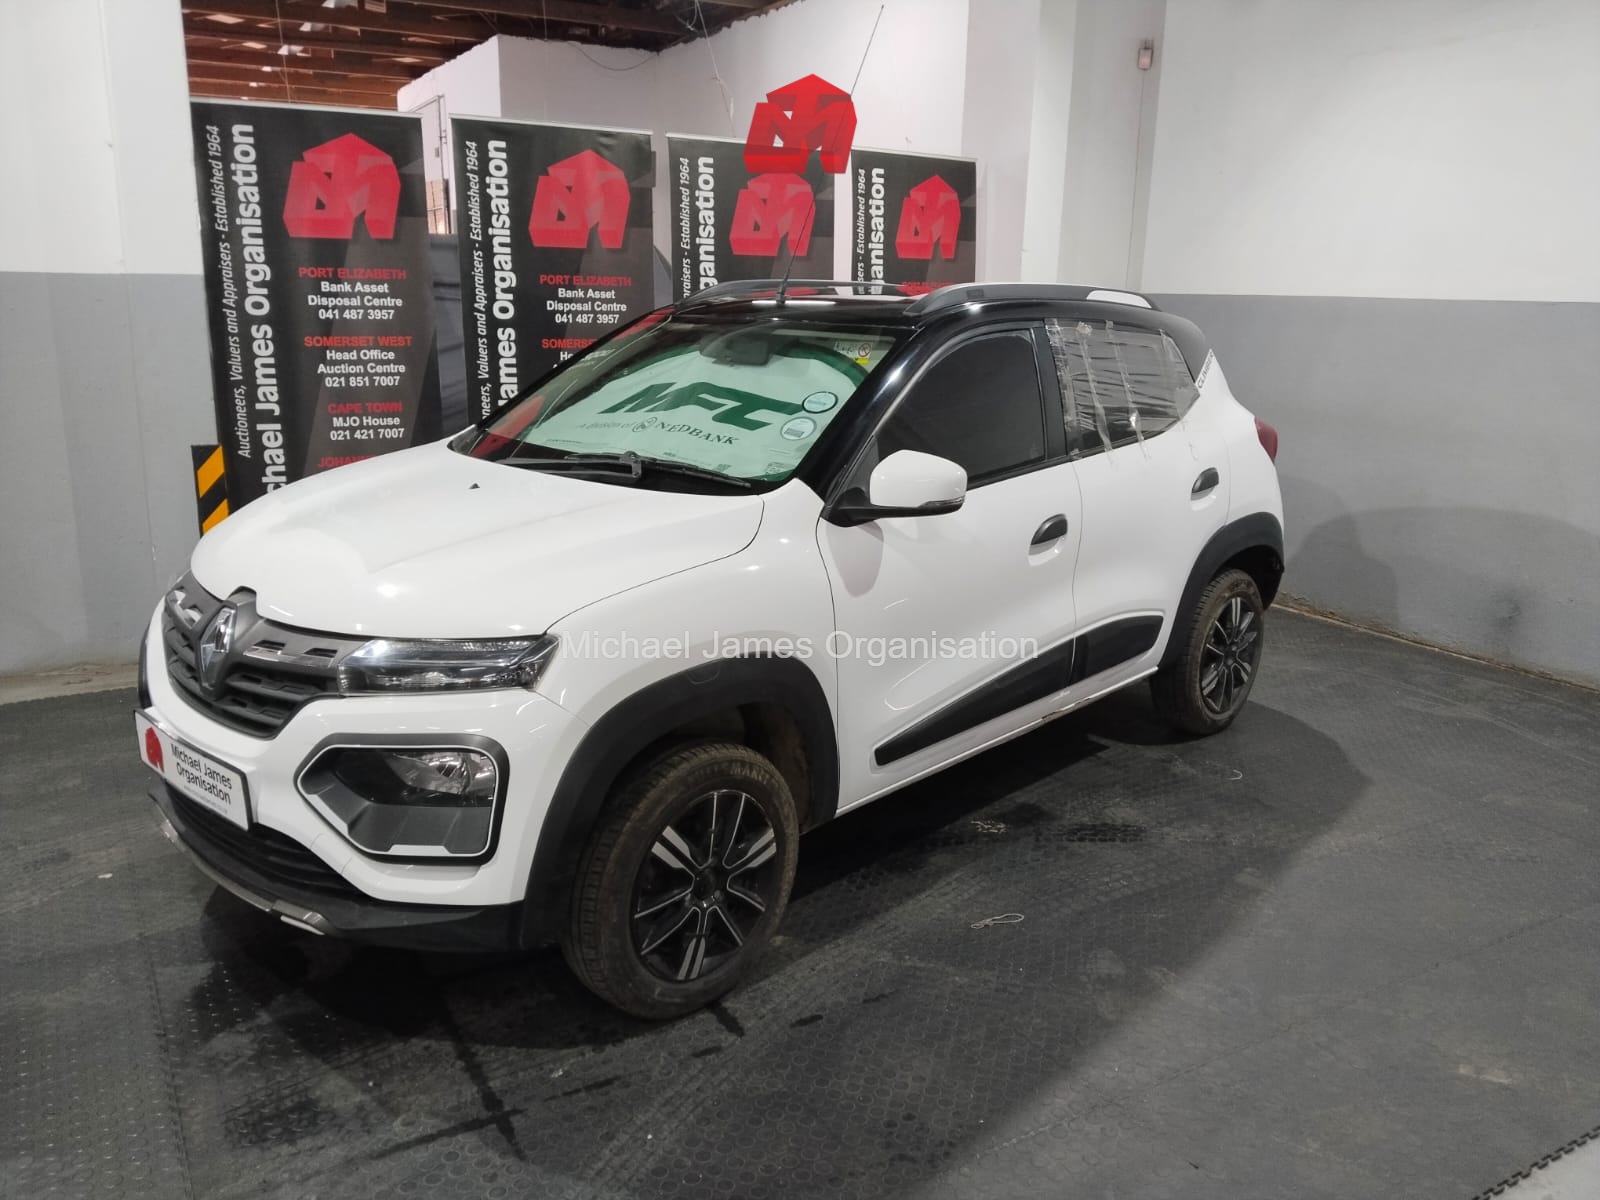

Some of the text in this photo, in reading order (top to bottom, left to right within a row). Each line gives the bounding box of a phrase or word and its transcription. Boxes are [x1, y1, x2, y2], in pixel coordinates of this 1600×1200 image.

[206, 125, 222, 156] 1964
[465, 140, 478, 170] 1964
[680, 157, 690, 184] 1964
[858, 168, 866, 194] 1964
[208, 159, 228, 232] Established
[466, 173, 482, 240] Established
[486, 140, 517, 319] Organisation
[680, 186, 691, 249] Established
[695, 156, 719, 290] ganisation
[856, 196, 865, 254] Established
[868, 167, 885, 281] anisation
[218, 242, 238, 307] Appraisers
[298, 267, 407, 279] PORT ELIZABETH
[471, 249, 487, 311] Appraisers
[539, 275, 632, 286] PORT ELIZABETH
[321, 281, 389, 293] Bank Asset
[558, 288, 616, 299] Bank Asset
[230, 124, 287, 493] chael James Organisation
[307, 295, 403, 308] Disposal Centre
[318, 309, 395, 320] 041 487 3957
[546, 300, 627, 313] Disposal Centre
[222, 308, 239, 333] and
[473, 312, 487, 335] and
[555, 314, 620, 324] 041 487 3957
[304, 336, 413, 347] SOMERSET WEST
[227, 336, 243, 380] Valuers
[317, 362, 406, 374] Auction Centre
[326, 349, 395, 361] Head Office
[476, 338, 489, 379] Valuers
[325, 376, 401, 387] 021 851 7007
[327, 402, 403, 414] CAPE TOWN
[481, 383, 492, 419] neers,
[234, 385, 251, 458] Auctioneers,
[330, 428, 404, 440] 021 421 7007
[333, 416, 400, 427] MJO House
[655, 421, 739, 445] NEDBANK
[171, 743, 232, 790] Michael James
[176, 761, 231, 804] Organisation
